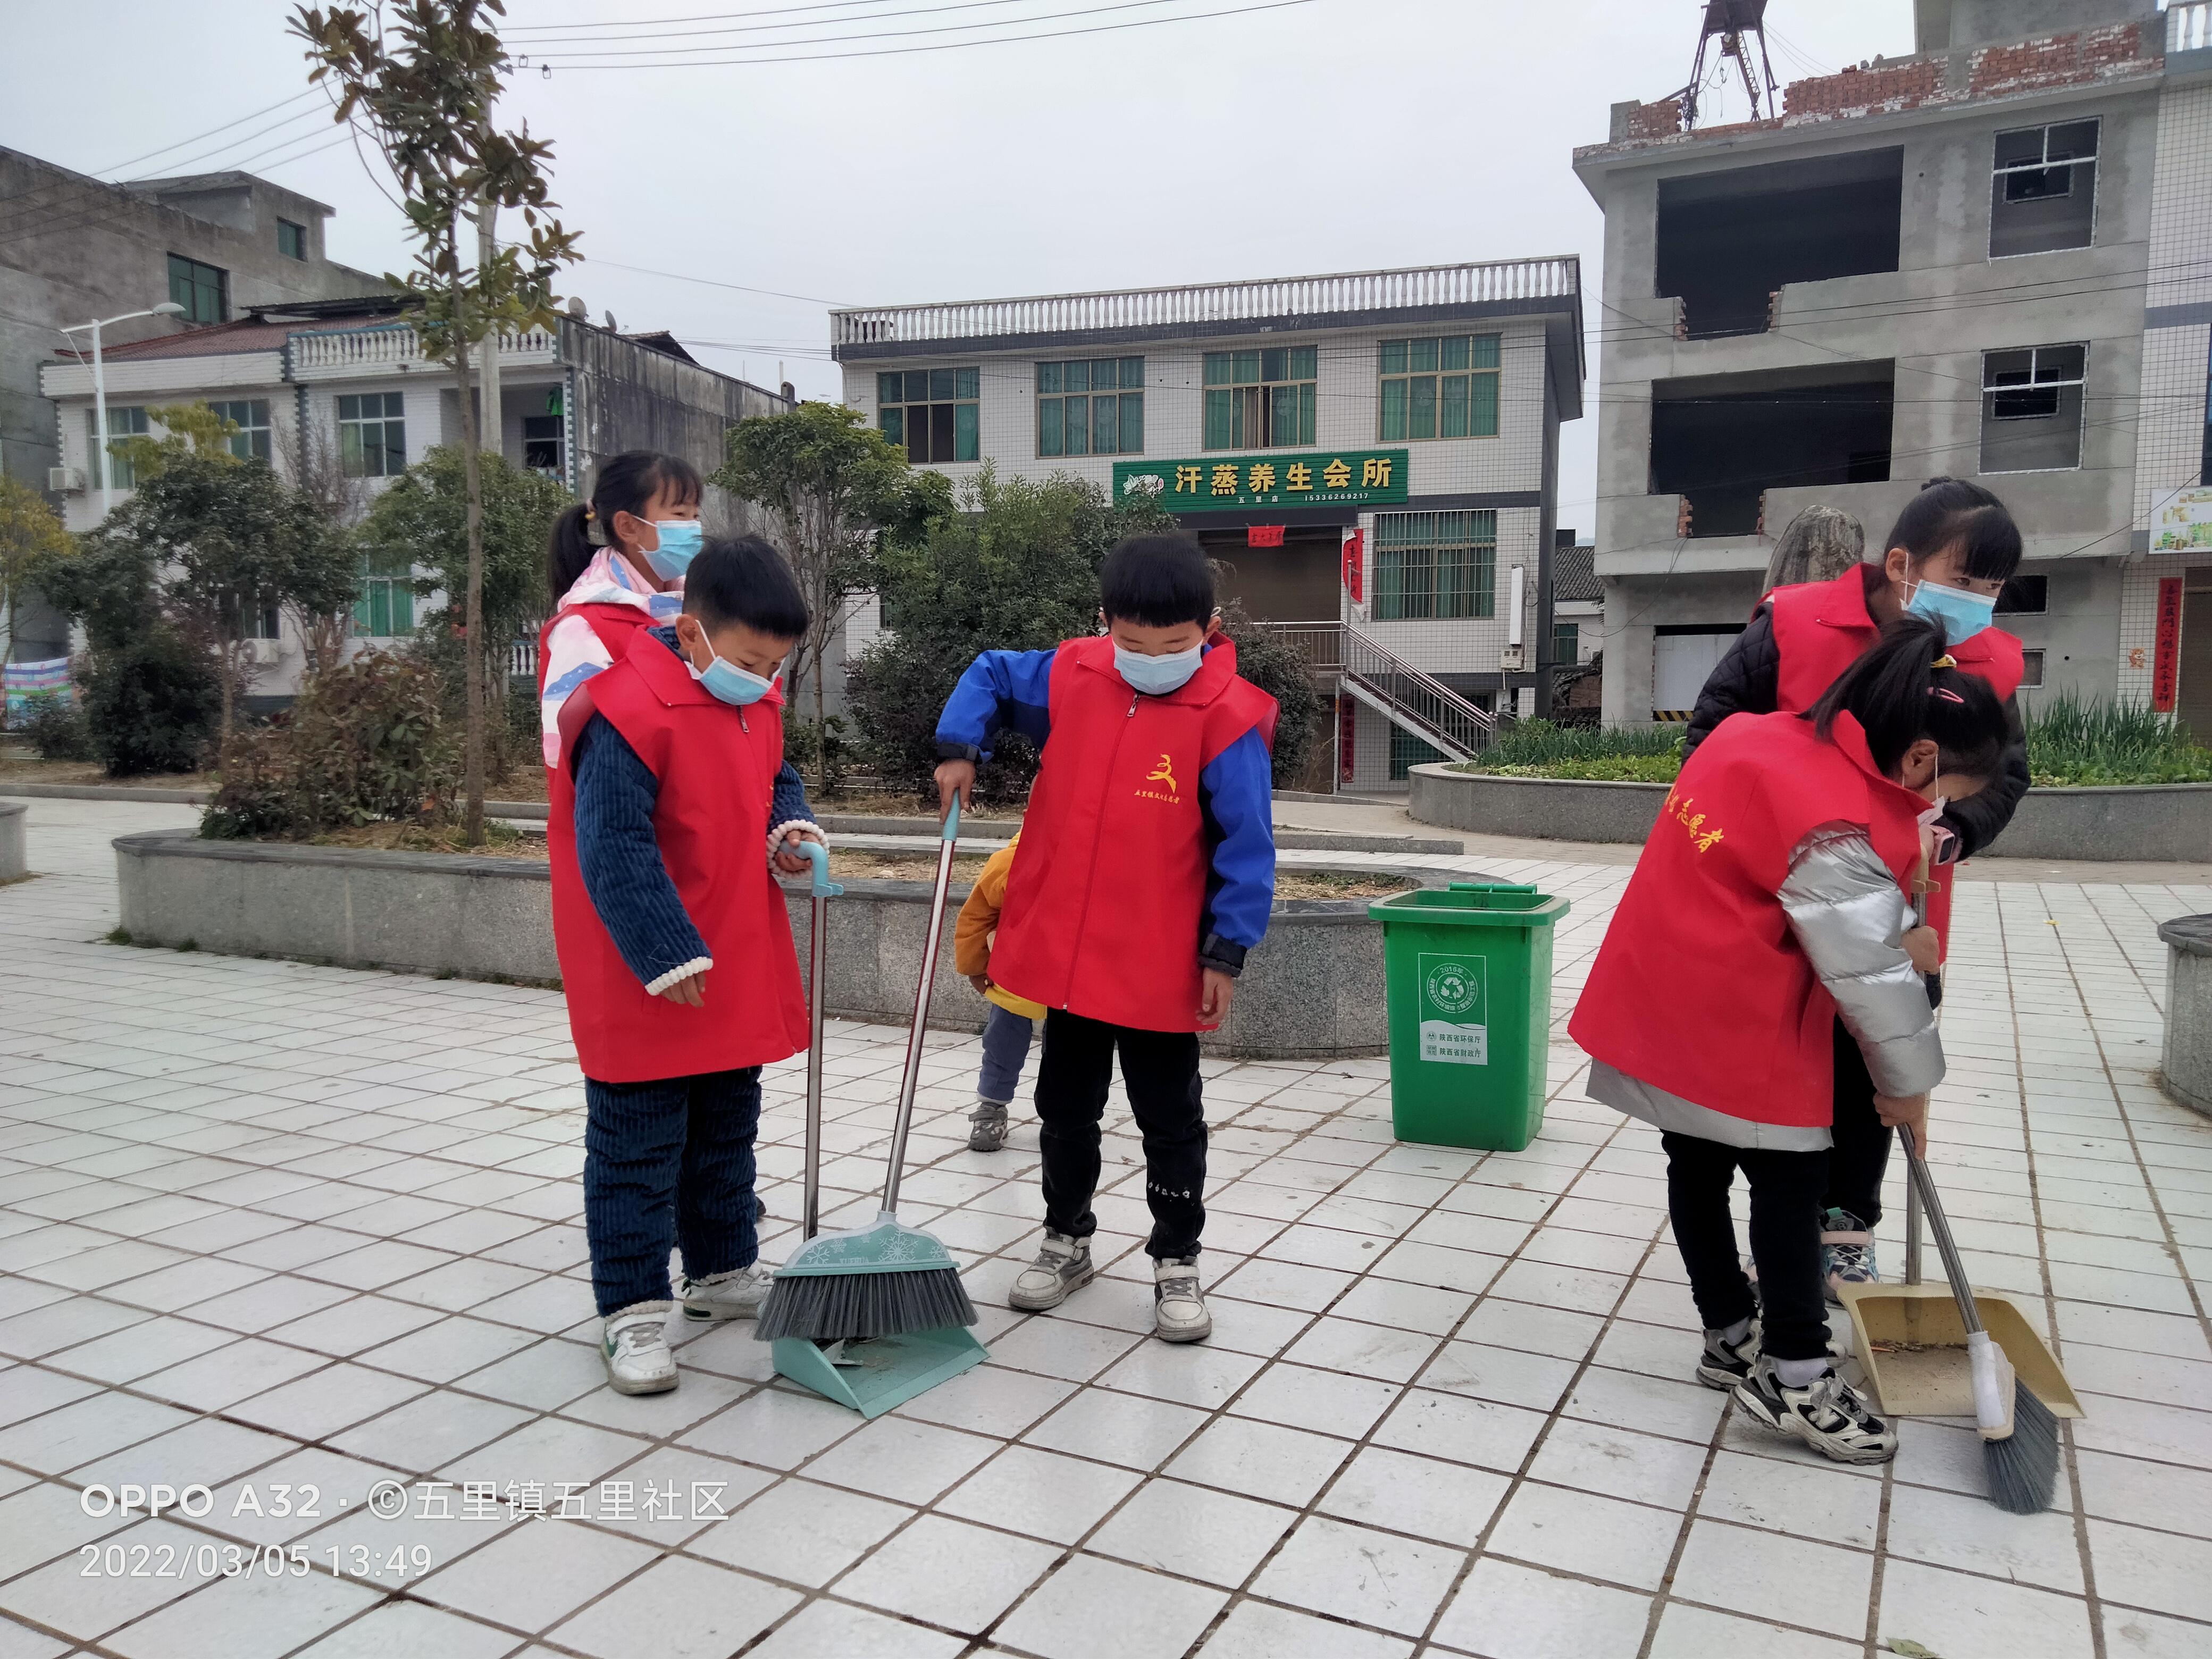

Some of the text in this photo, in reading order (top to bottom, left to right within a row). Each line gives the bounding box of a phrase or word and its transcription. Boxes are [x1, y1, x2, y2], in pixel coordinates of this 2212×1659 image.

[1175, 458, 1392, 496] 汗蒸养生会所
[1305, 493, 1368, 502] 15336269217
[1439, 1034, 1481, 1043] 陕西省环保厅
[1439, 1048, 1481, 1058] 陕西省财政厅
